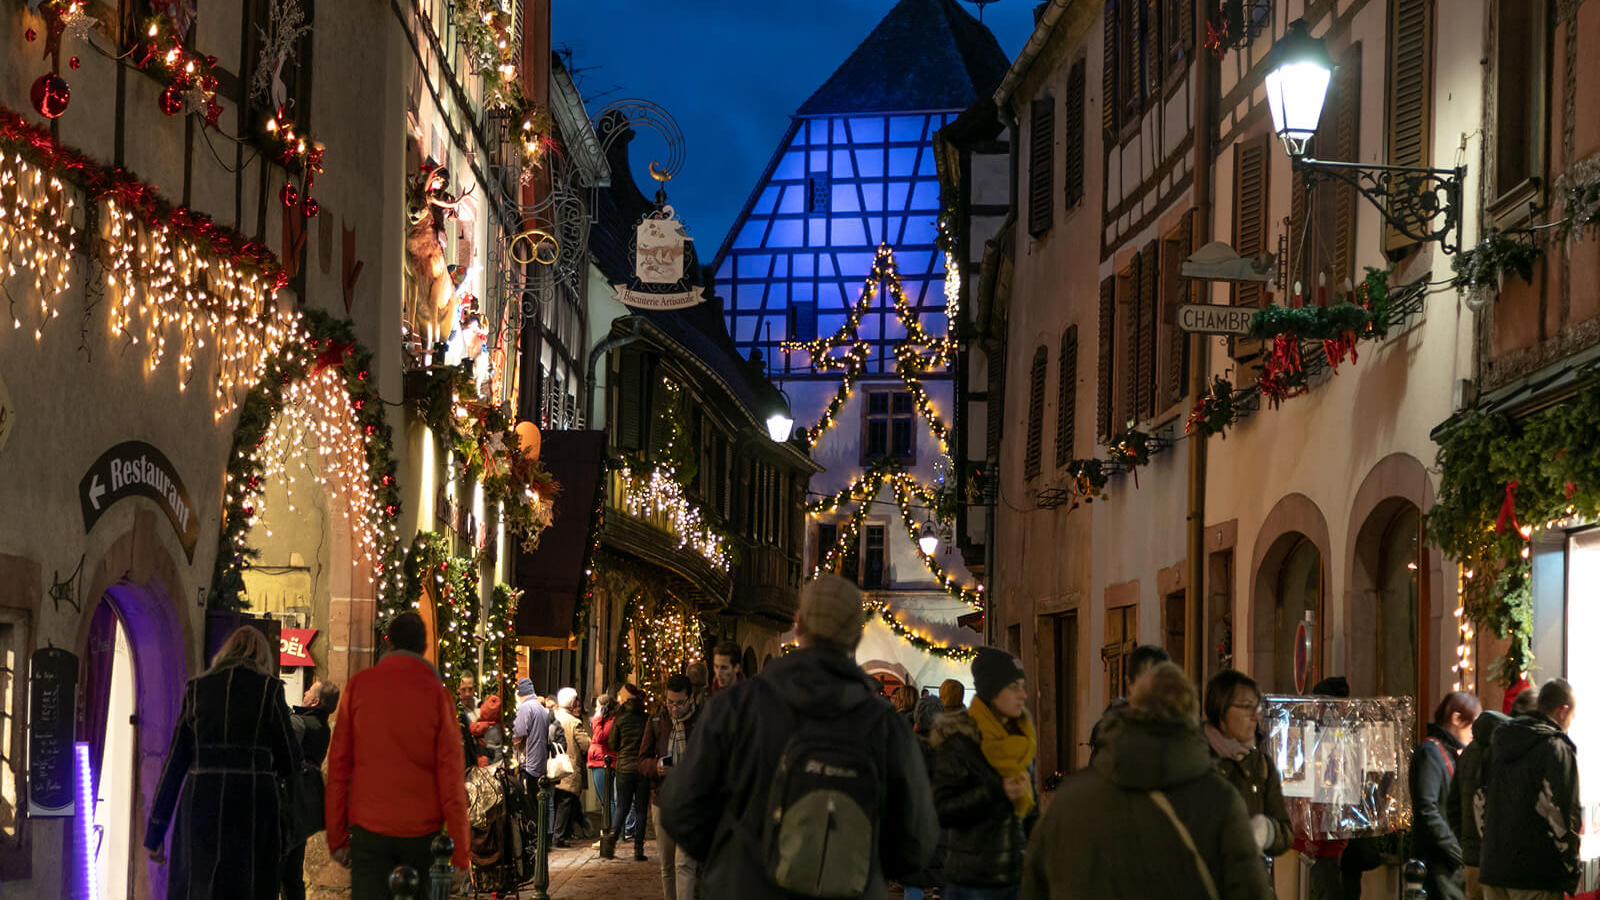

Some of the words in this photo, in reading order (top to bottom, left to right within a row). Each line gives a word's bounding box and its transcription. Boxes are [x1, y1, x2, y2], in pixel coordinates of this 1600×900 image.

[624, 291, 659, 306] Biscuiterie
[660, 295, 694, 307] Artisanale
[1184, 309, 1251, 331] CHAMBR
[110, 454, 189, 534] Restaurant
[280, 637, 306, 658] OËL
